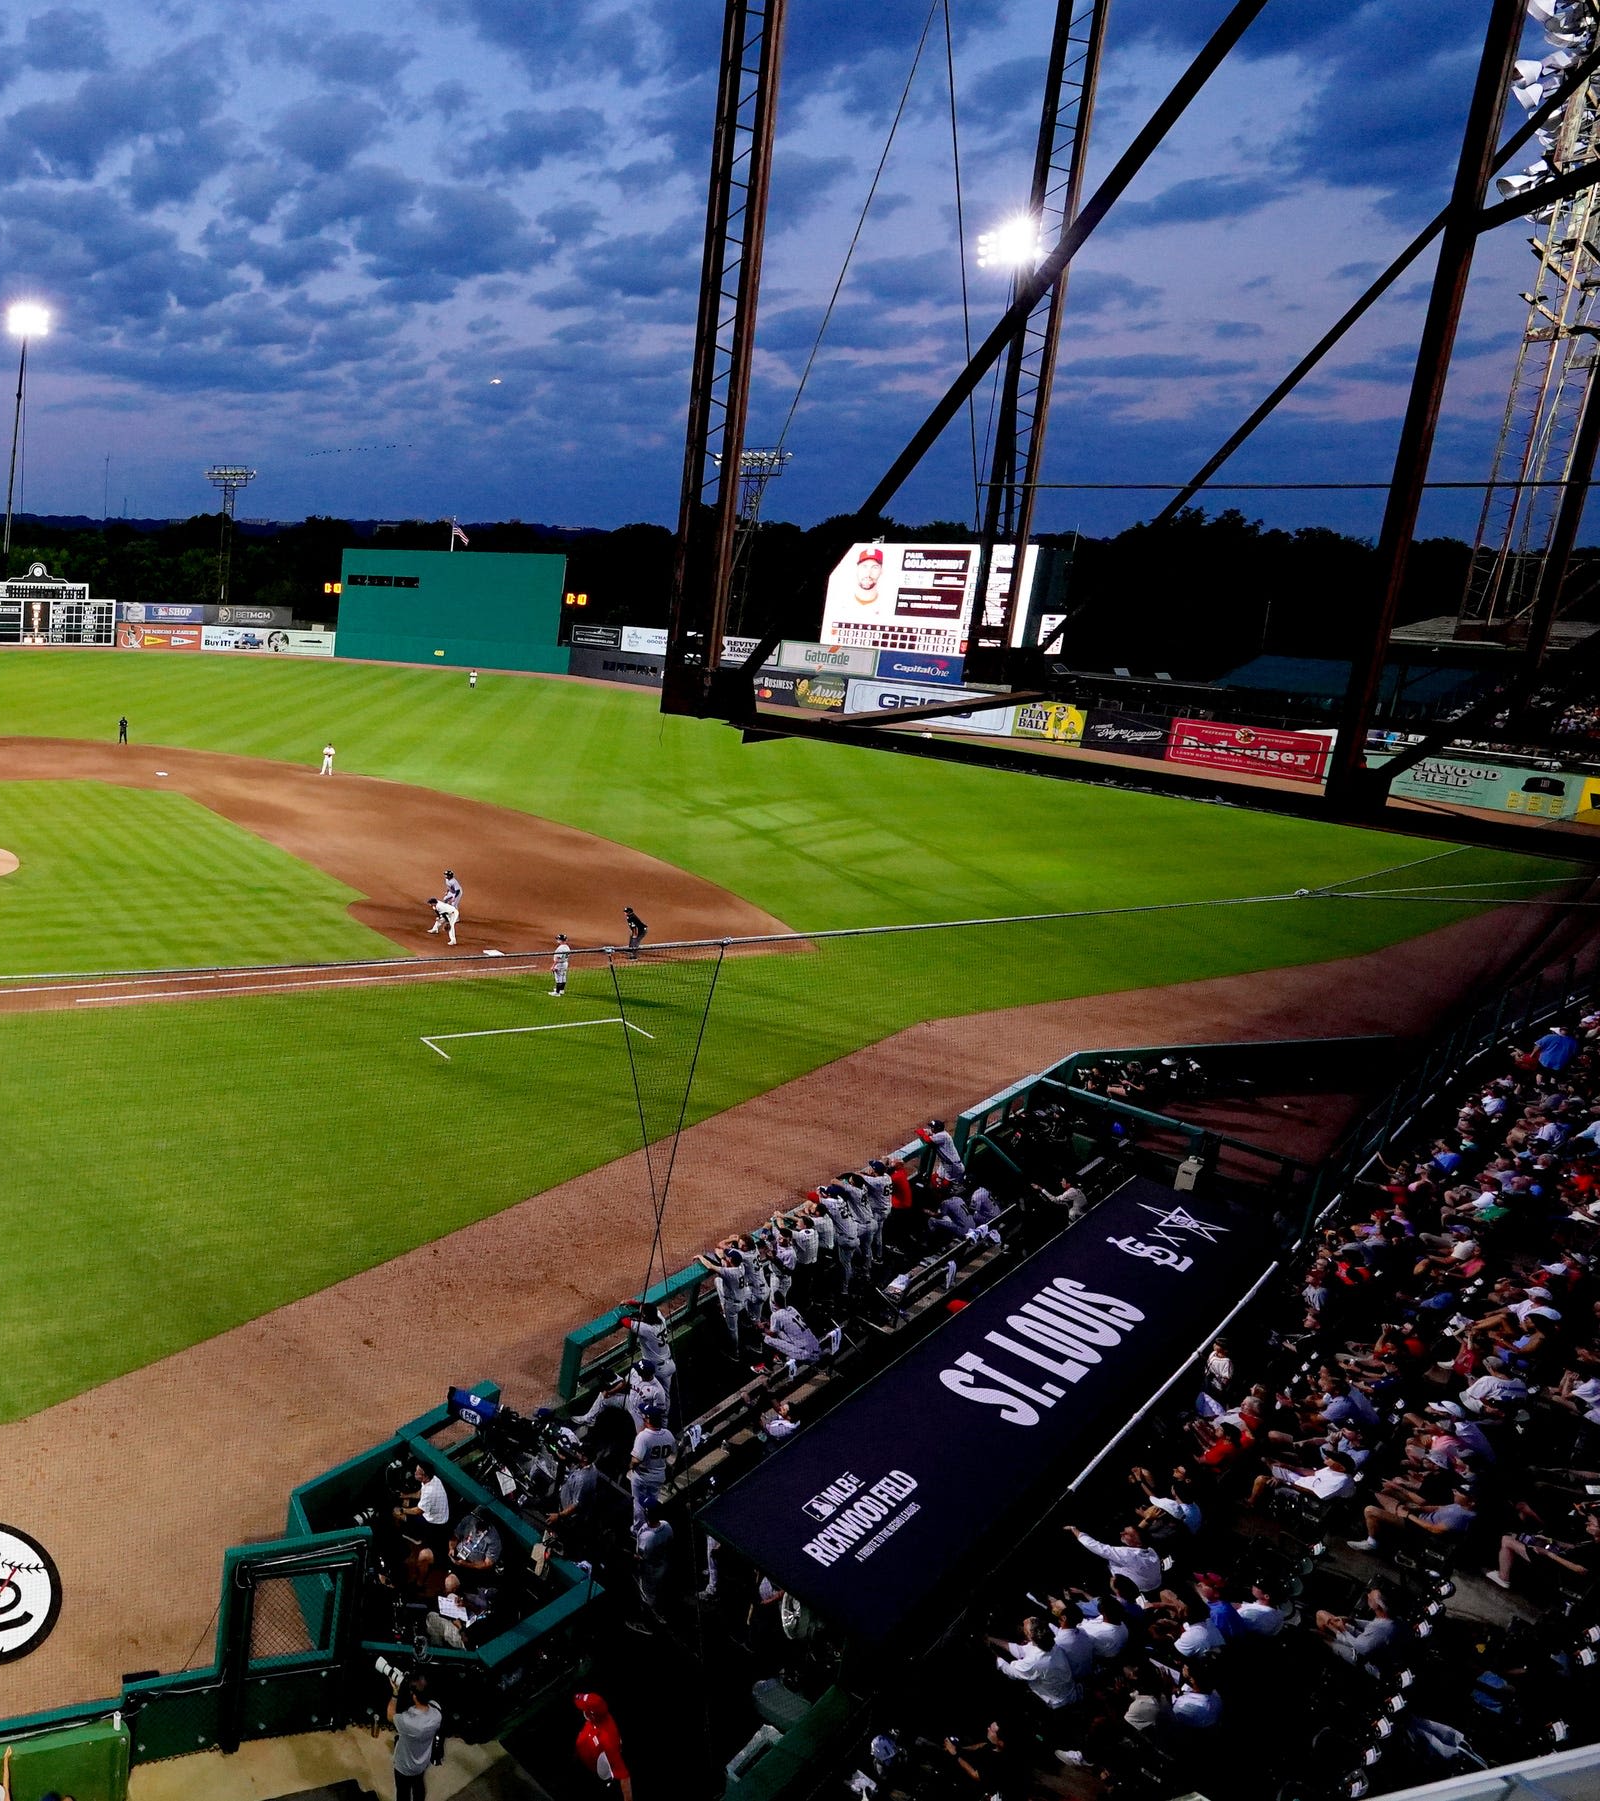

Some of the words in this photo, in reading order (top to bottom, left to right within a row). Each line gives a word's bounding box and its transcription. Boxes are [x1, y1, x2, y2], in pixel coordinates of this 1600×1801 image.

[168, 607, 192, 616] SHOP
[804, 649, 850, 666] Gatorade
[763, 677, 794, 690] BUSINESS
[807, 696, 843, 707] SHUCKS
[1020, 708, 1053, 721] PLAY
[1018, 718, 1050, 731] BALL
[1182, 735, 1311, 766] Budweiser
[1413, 770, 1475, 788] FIELD
[983, 1276, 1146, 1385] LOUIS
[938, 1350, 1067, 1427] ST.
[820, 1477, 858, 1507] MLB
[801, 1494, 889, 1568] RICKWOOD
[868, 1469, 919, 1508] FIELD
